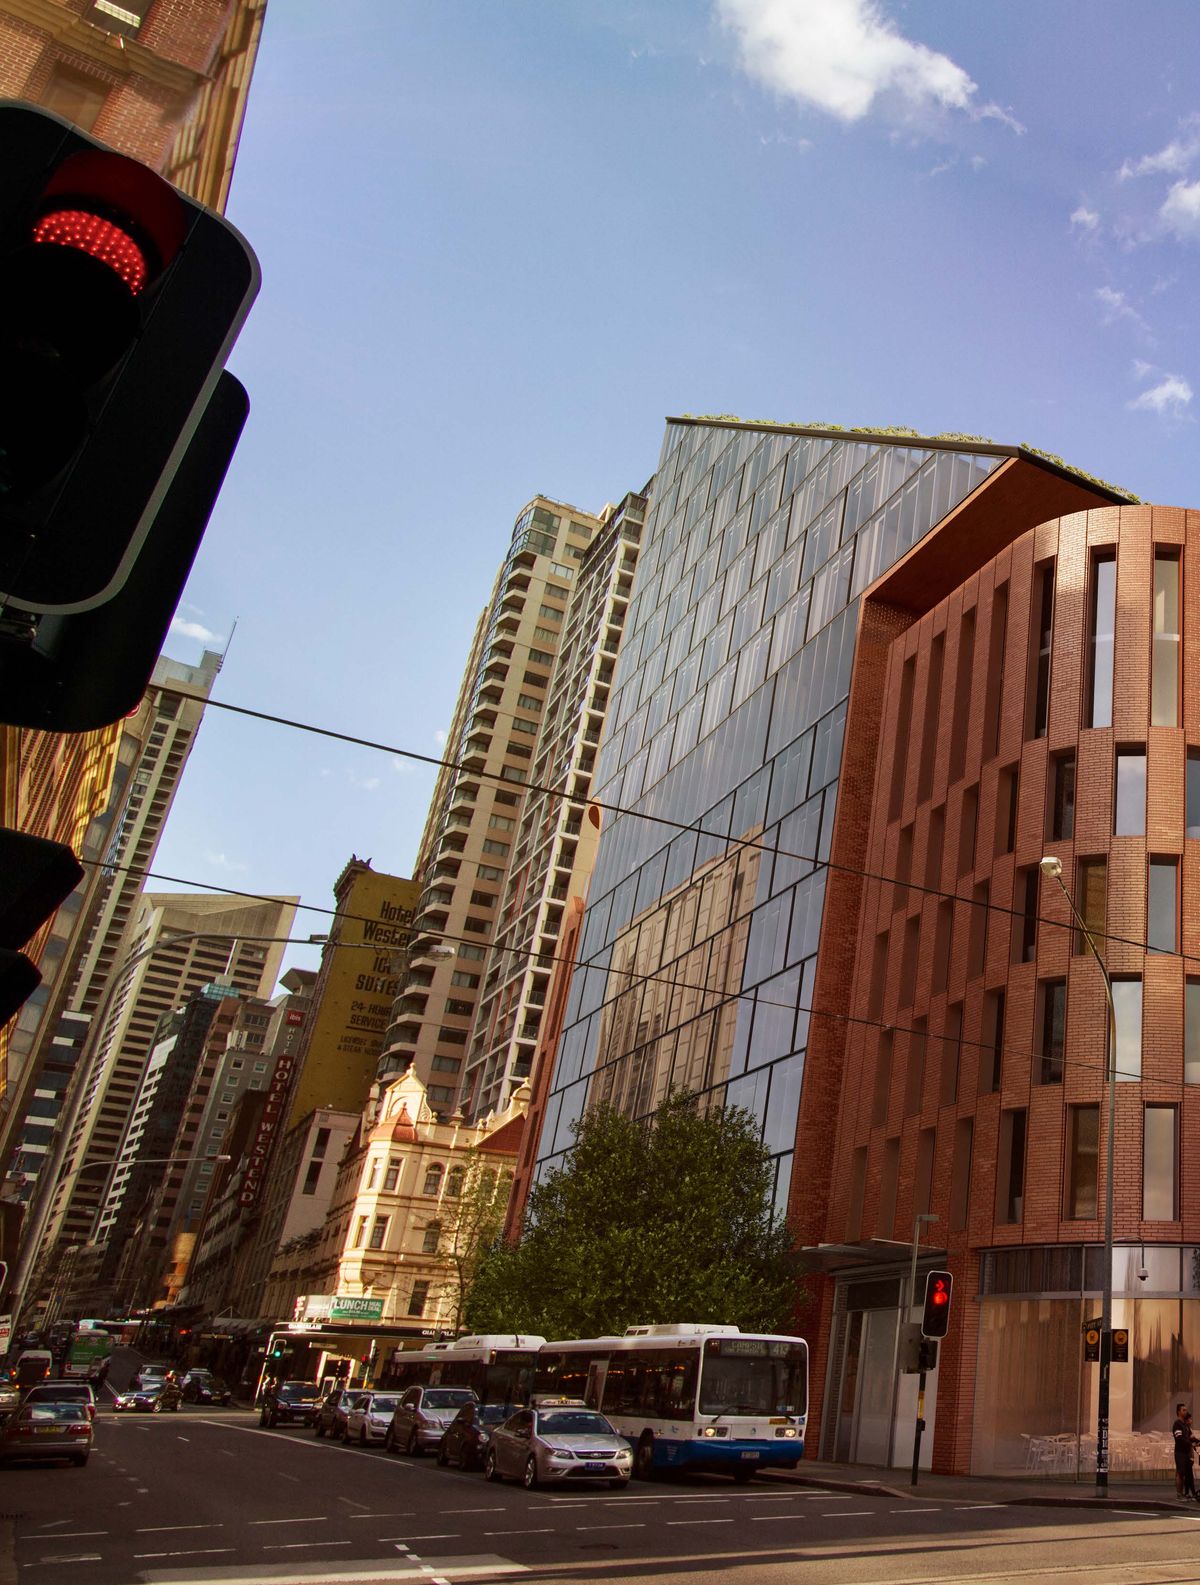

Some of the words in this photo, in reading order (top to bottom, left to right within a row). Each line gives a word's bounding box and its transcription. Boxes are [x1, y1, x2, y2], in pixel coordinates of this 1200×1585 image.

[380, 901, 416, 925] Hotel
[350, 1014, 387, 1030] SERVICE
[283, 1027, 295, 1055] HOTE
[266, 1060, 292, 1113] HOTEL
[241, 1122, 274, 1201] WESTEND
[334, 1299, 368, 1310] LUNCH
